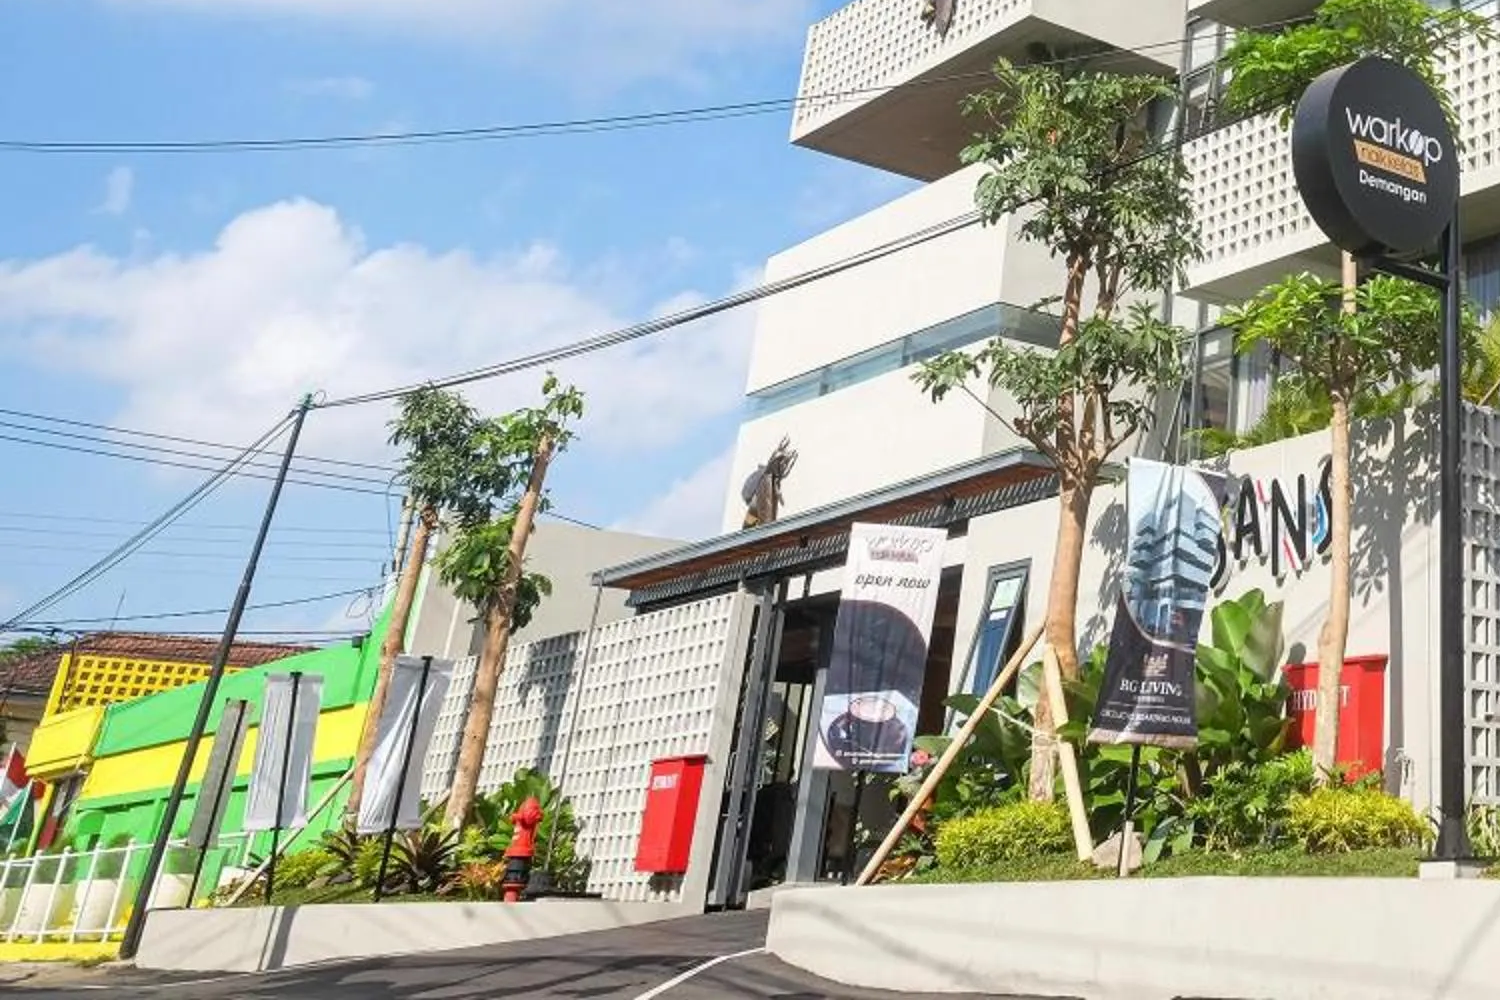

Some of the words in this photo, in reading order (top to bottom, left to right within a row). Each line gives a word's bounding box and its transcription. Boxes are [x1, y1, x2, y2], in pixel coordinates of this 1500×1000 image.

[1345, 106, 1443, 168] warkop
[1359, 168, 1427, 204] Demangan
[854, 573, 893, 590] open
[896, 577, 931, 589] now
